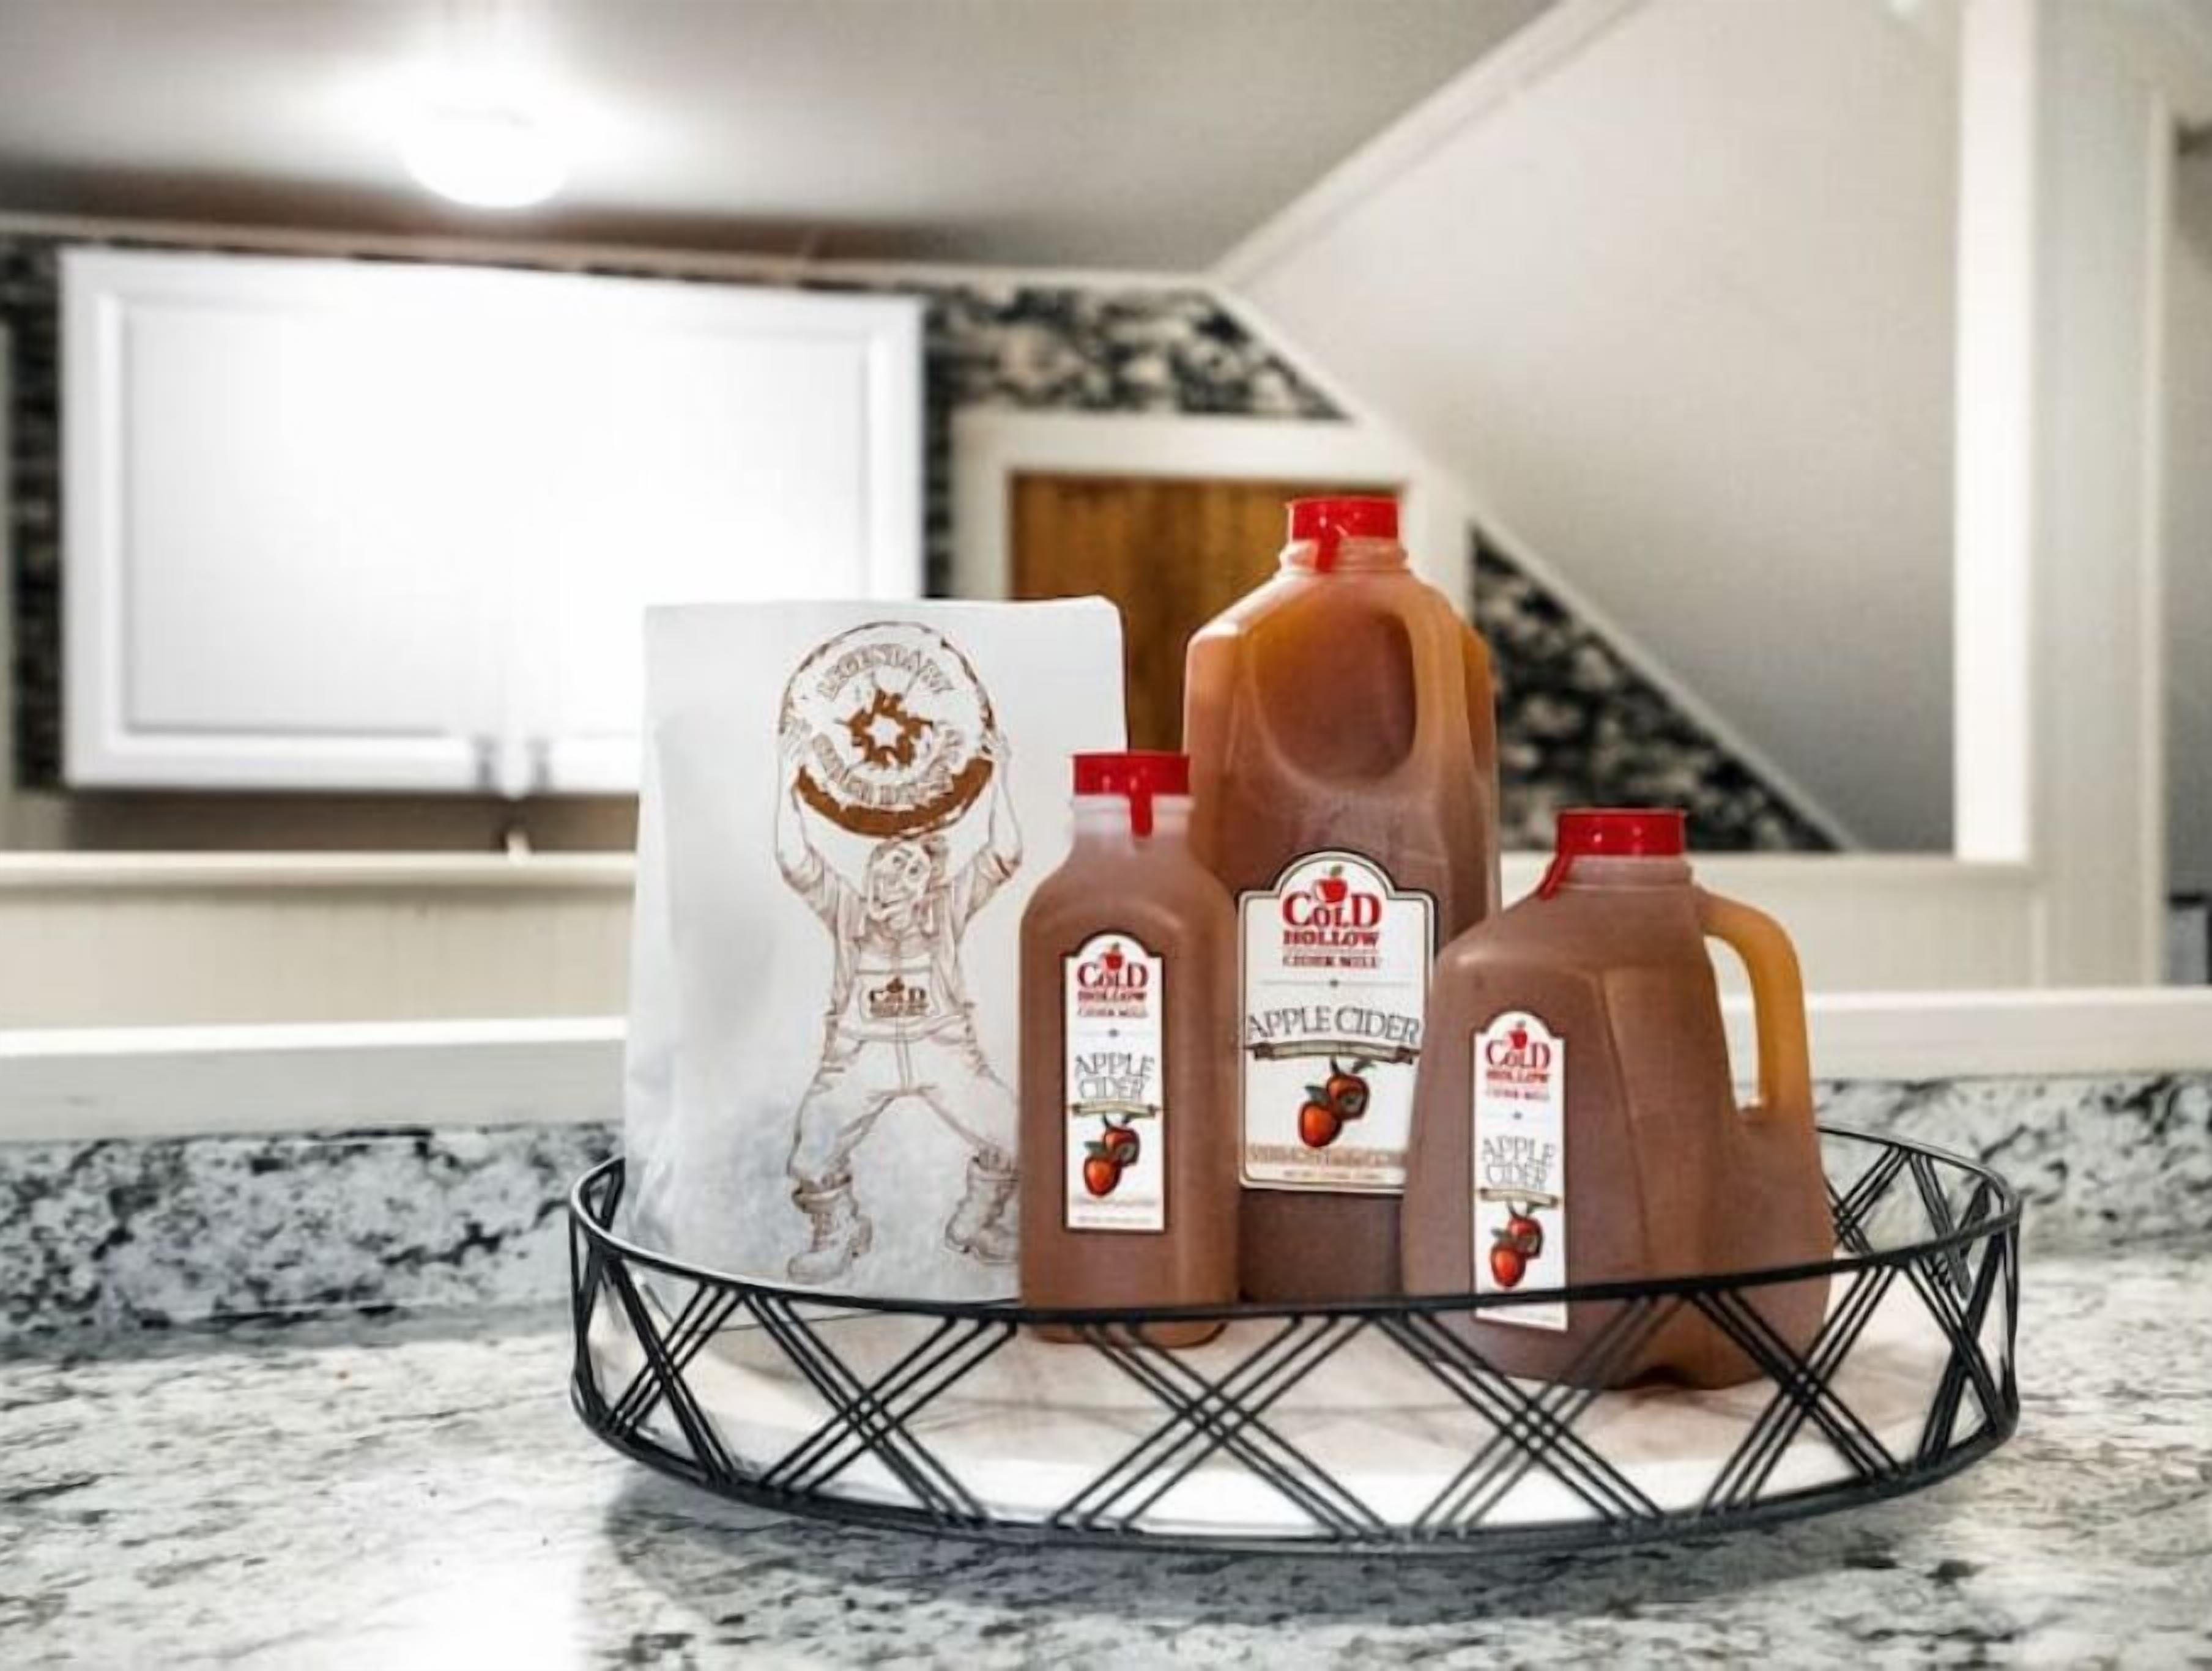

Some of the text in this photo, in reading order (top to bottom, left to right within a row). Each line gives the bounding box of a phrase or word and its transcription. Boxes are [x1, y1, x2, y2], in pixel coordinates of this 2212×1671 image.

[1282, 892, 1382, 927] COLD
[1283, 930, 1380, 946] HOLLOW
[1077, 962, 1149, 987] COLD
[1247, 1006, 1420, 1044] APPLE CIDER
[1075, 1052, 1156, 1077] APPLE
[1078, 1076, 1151, 1099] CIDER
[1482, 1135, 1556, 1166] APPLE
[1485, 1163, 1548, 1192] CIDER
